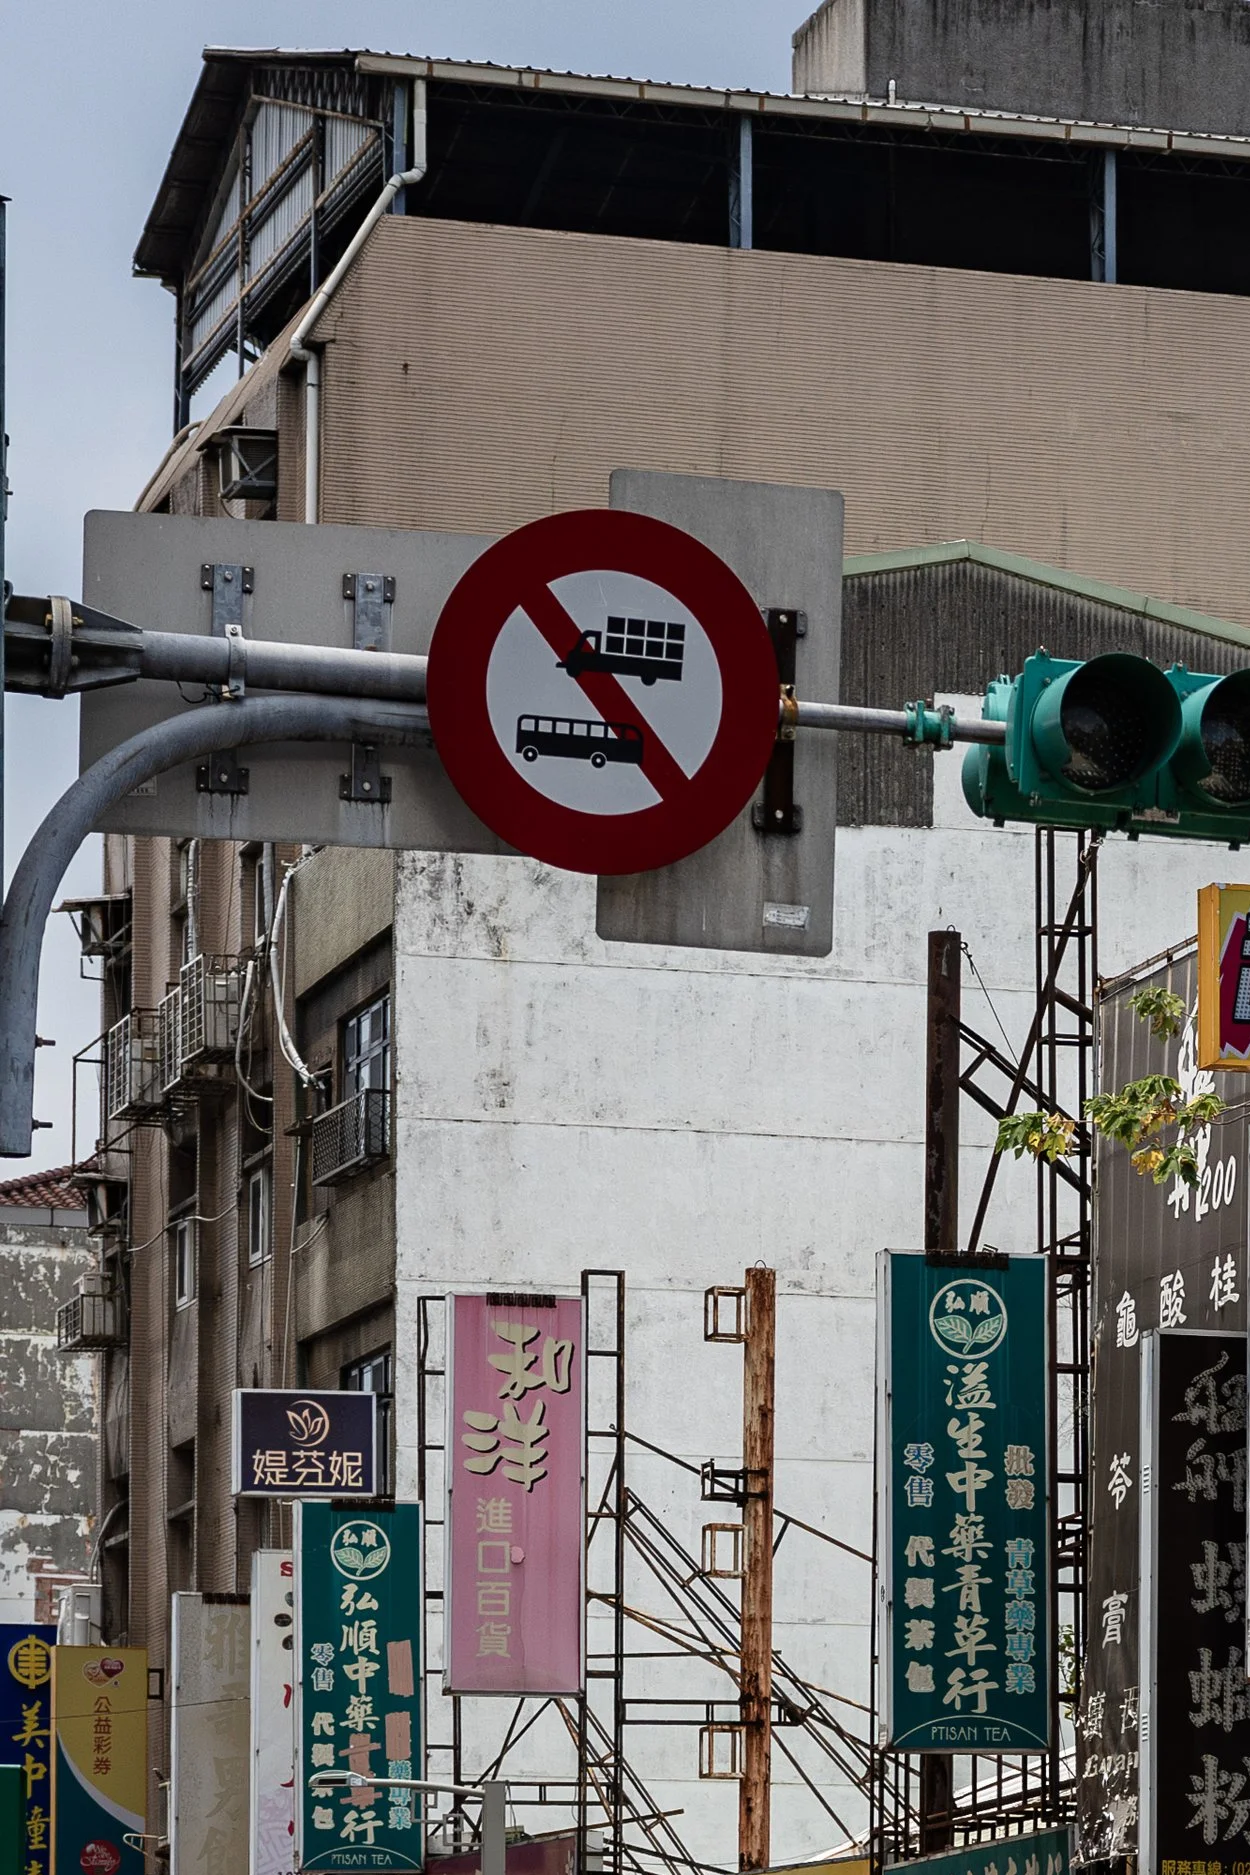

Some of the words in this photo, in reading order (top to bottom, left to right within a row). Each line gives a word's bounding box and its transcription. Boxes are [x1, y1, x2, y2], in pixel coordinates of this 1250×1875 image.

[461, 1320, 576, 1493] 和洋
[251, 1448, 364, 1487] 媞芬妮
[904, 1442, 936, 1507] 零售
[1004, 1444, 1036, 1510] 批發
[475, 1497, 513, 1658] 進口百貨
[941, 1361, 999, 1714] 溢生中藥青草行
[904, 1535, 936, 1693] 代製茶包
[1004, 1538, 1037, 1696] 青草藥專業
[92, 1695, 112, 1776] 公益彩券
[338, 1582, 384, 1845] 弘順中藥行
[930, 1726, 978, 1741] PTISAN
[984, 1727, 1012, 1742] TEA
[330, 1854, 366, 1866] PTISAN
[371, 1854, 393, 1866] TEA
